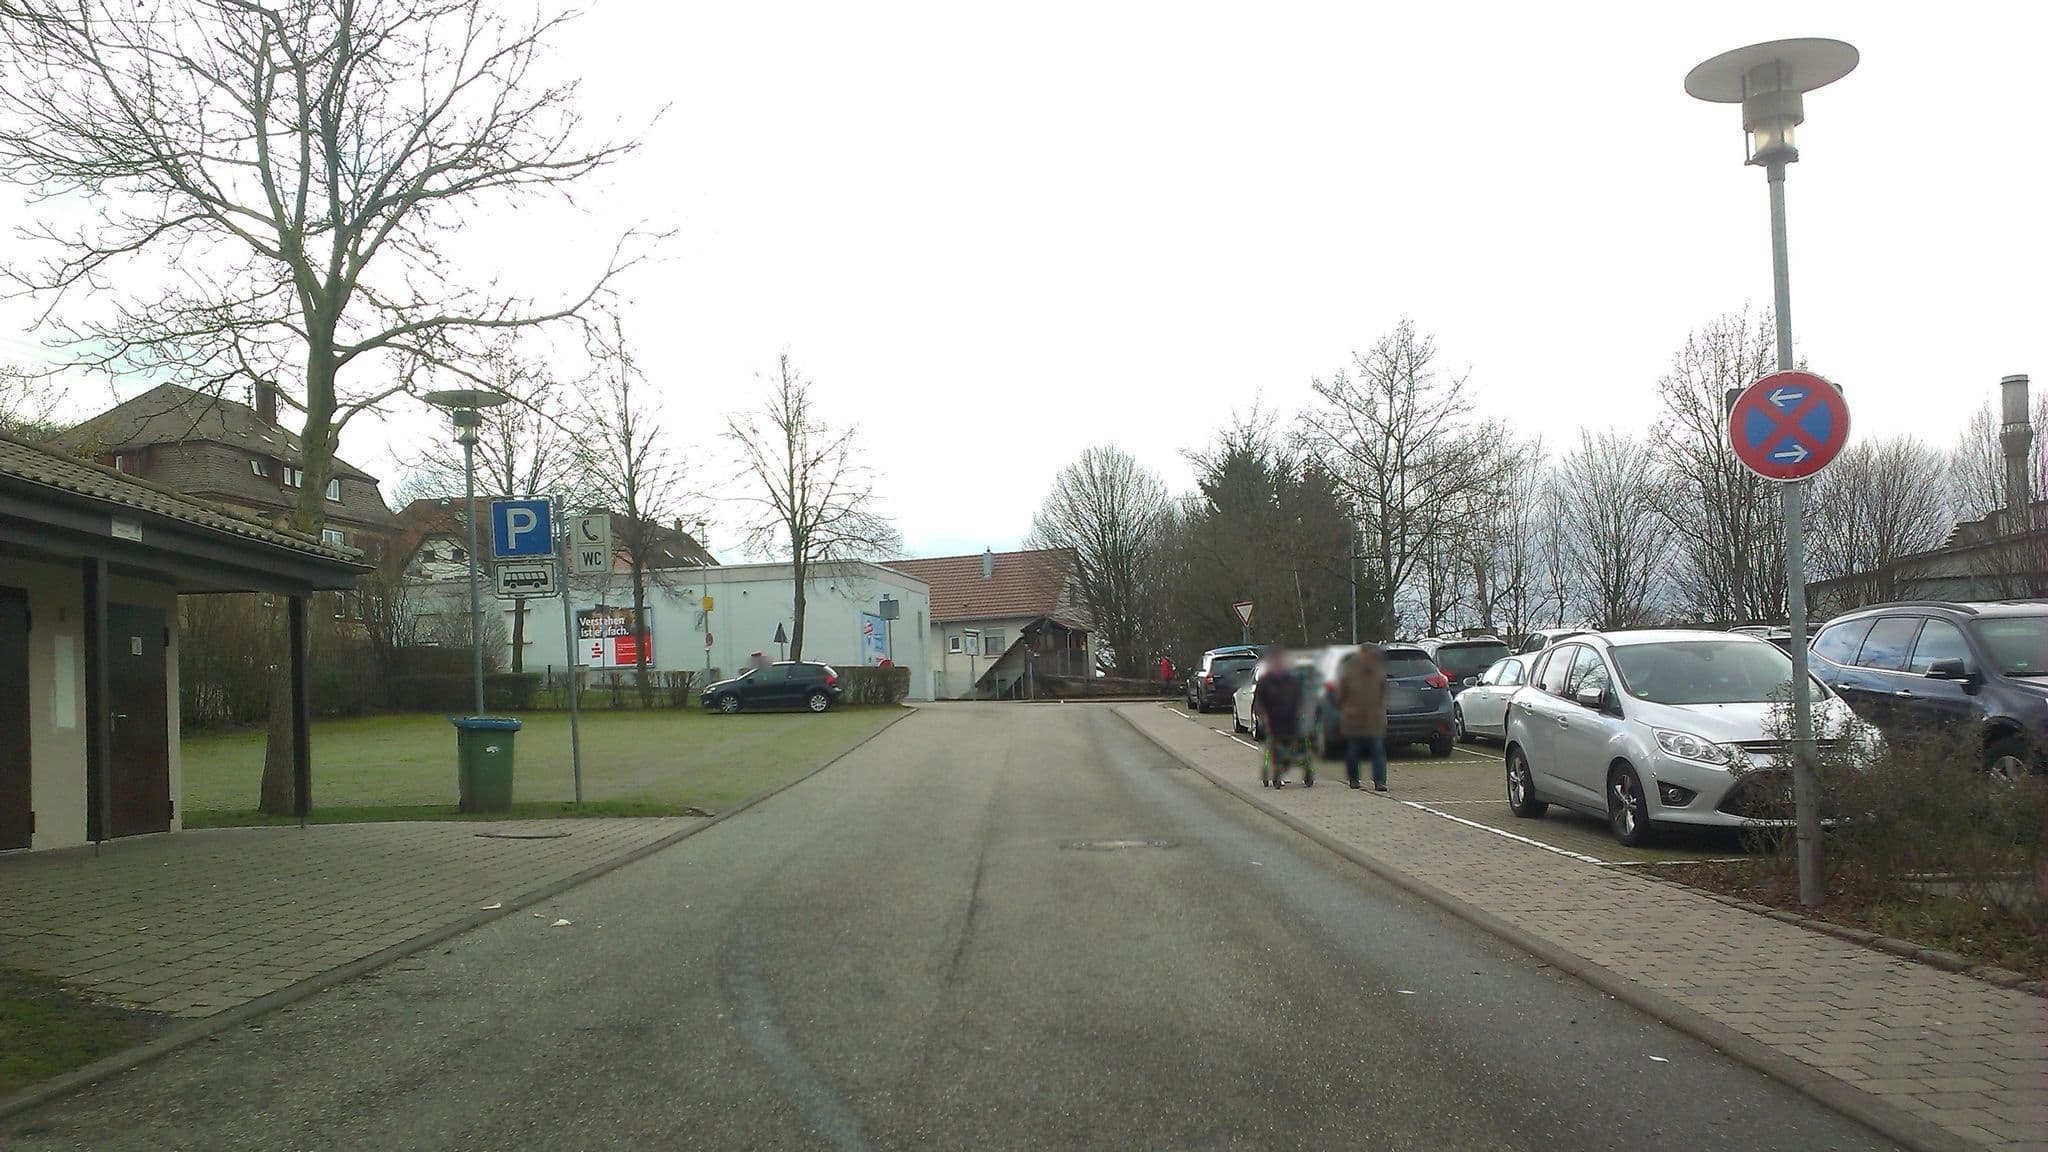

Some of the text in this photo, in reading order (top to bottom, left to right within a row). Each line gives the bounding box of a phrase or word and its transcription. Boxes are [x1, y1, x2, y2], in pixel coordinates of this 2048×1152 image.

[506, 508, 538, 550] P
[582, 551, 602, 566] WC
[579, 616, 625, 626] Verstehen
[581, 628, 592, 637] ist
